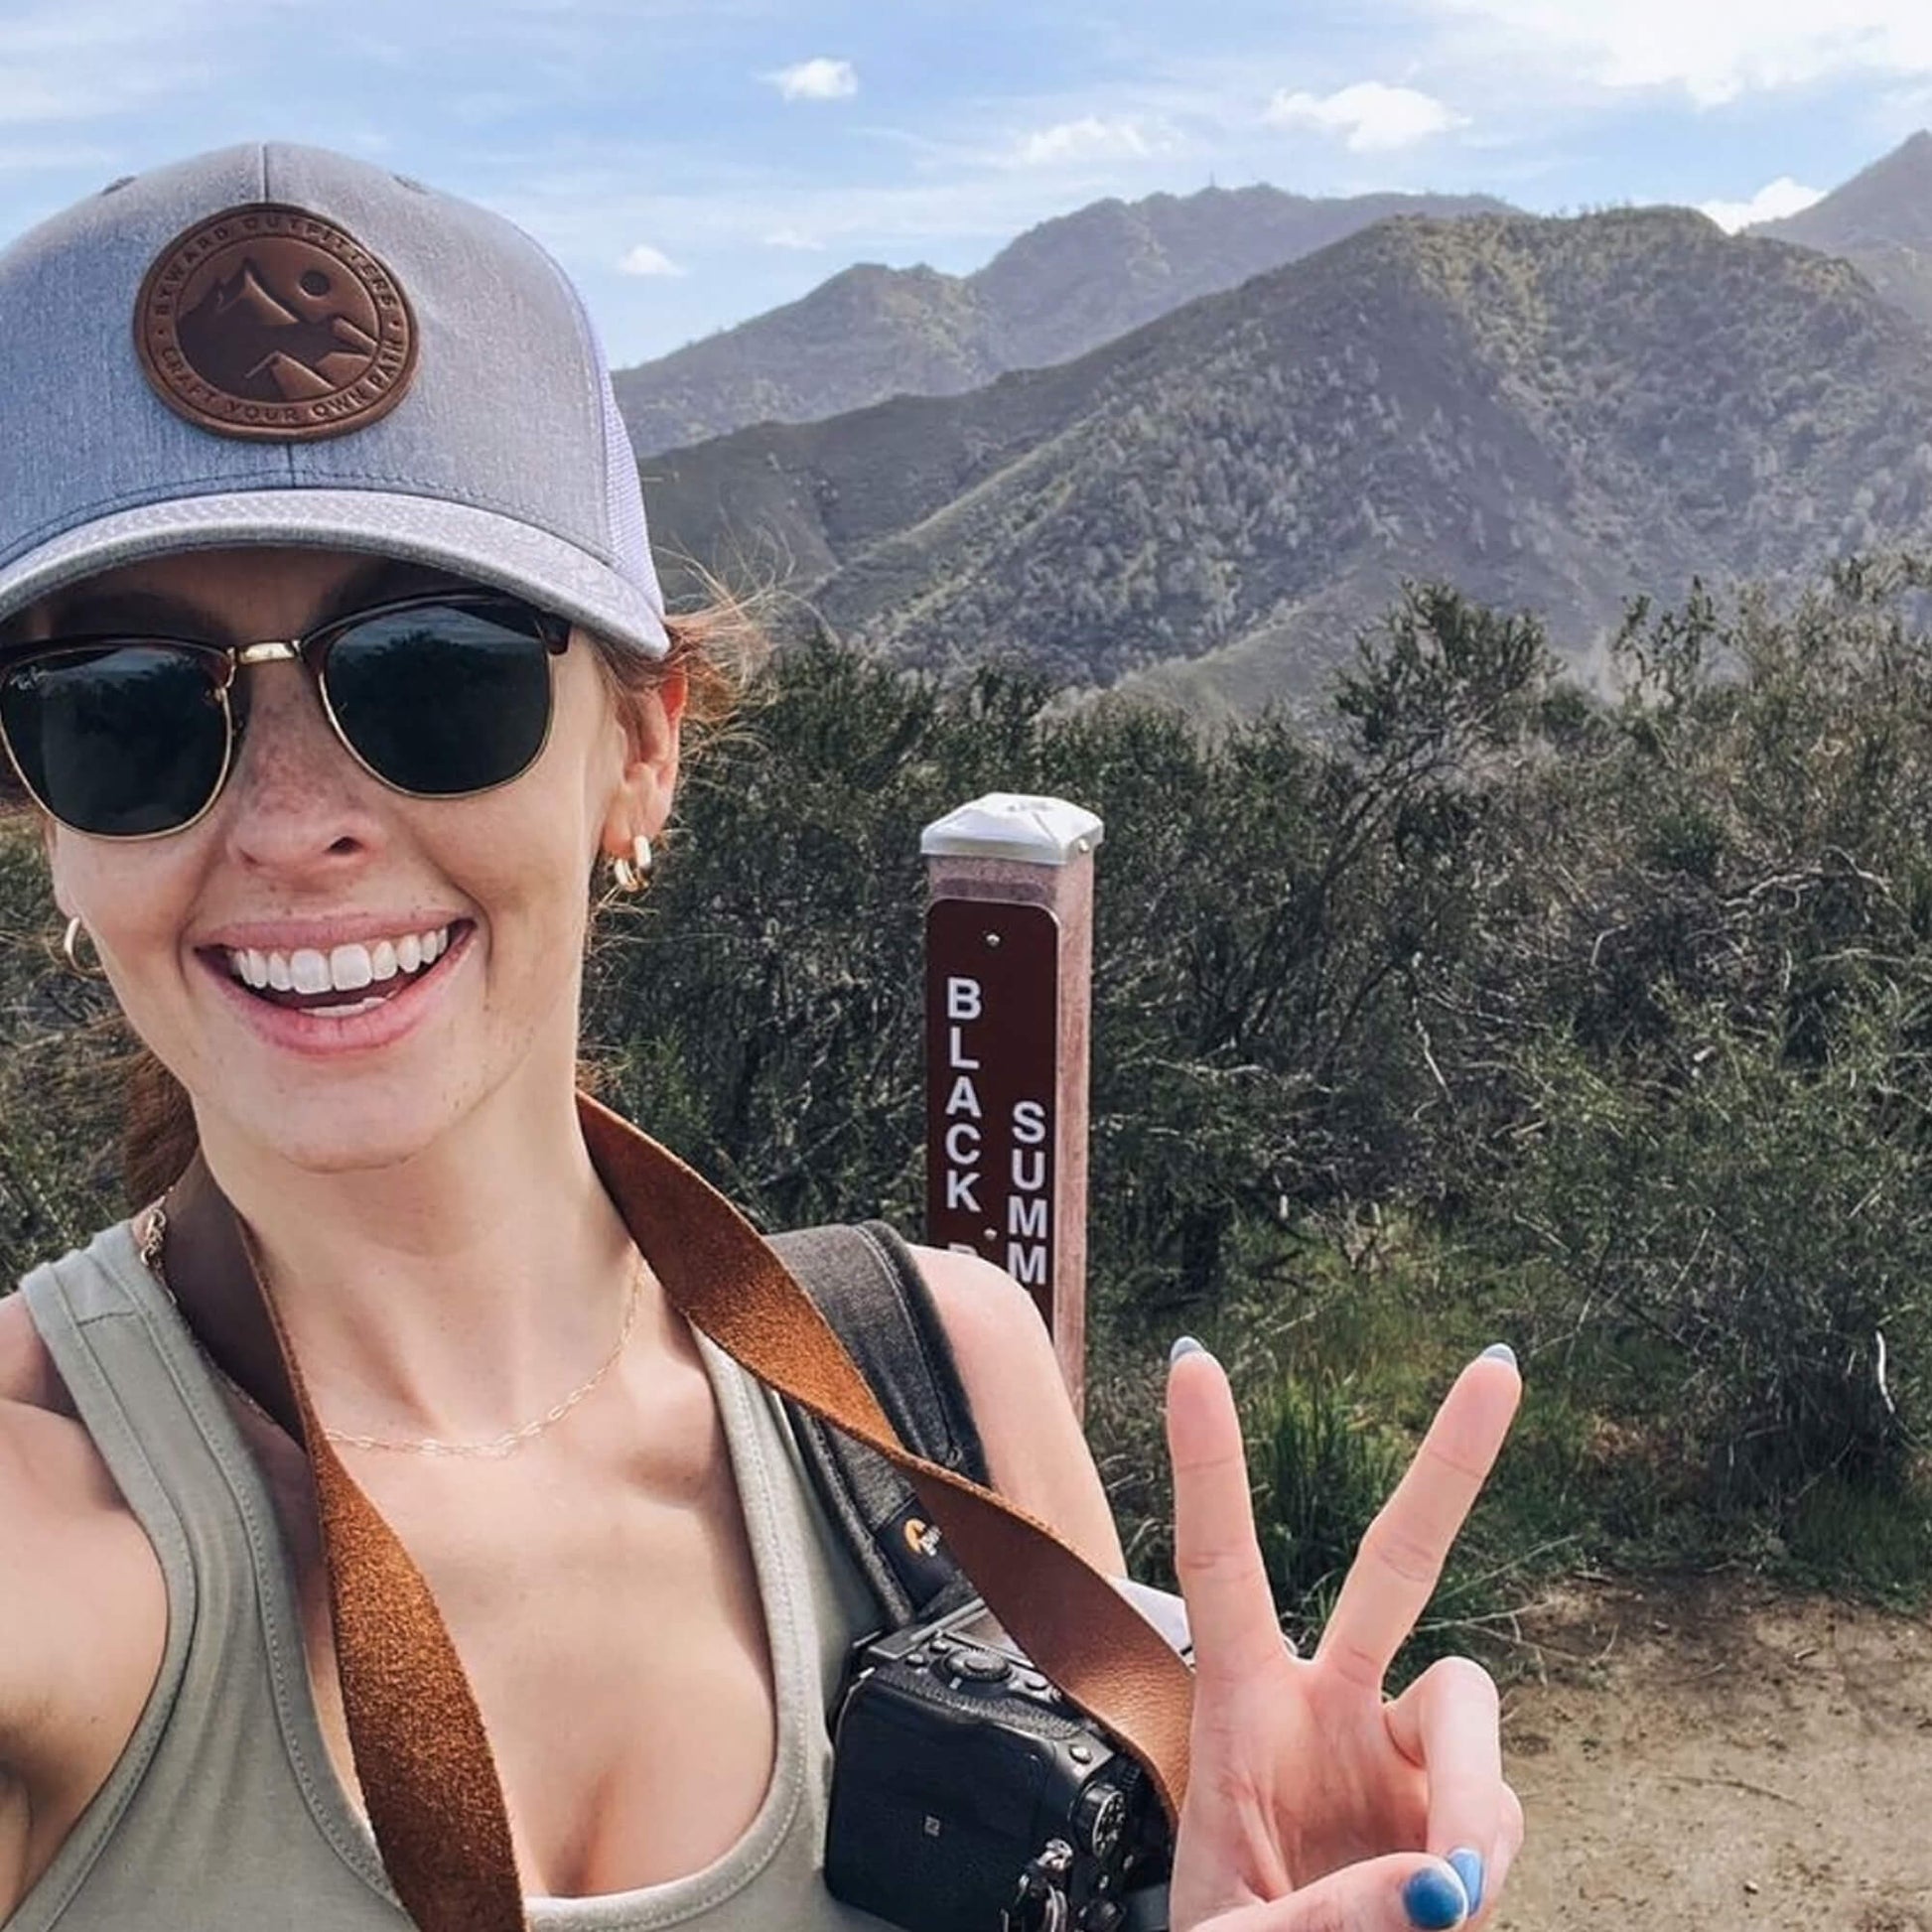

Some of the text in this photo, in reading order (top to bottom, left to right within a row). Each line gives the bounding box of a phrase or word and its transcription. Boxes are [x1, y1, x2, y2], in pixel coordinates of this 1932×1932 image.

[242, 215, 398, 307] OUTFITTERS
[162, 338, 404, 421] CRAFT YOUR OWN PATH
[945, 976, 983, 1213] BLACK
[1007, 1100, 1048, 1285] SUMM
